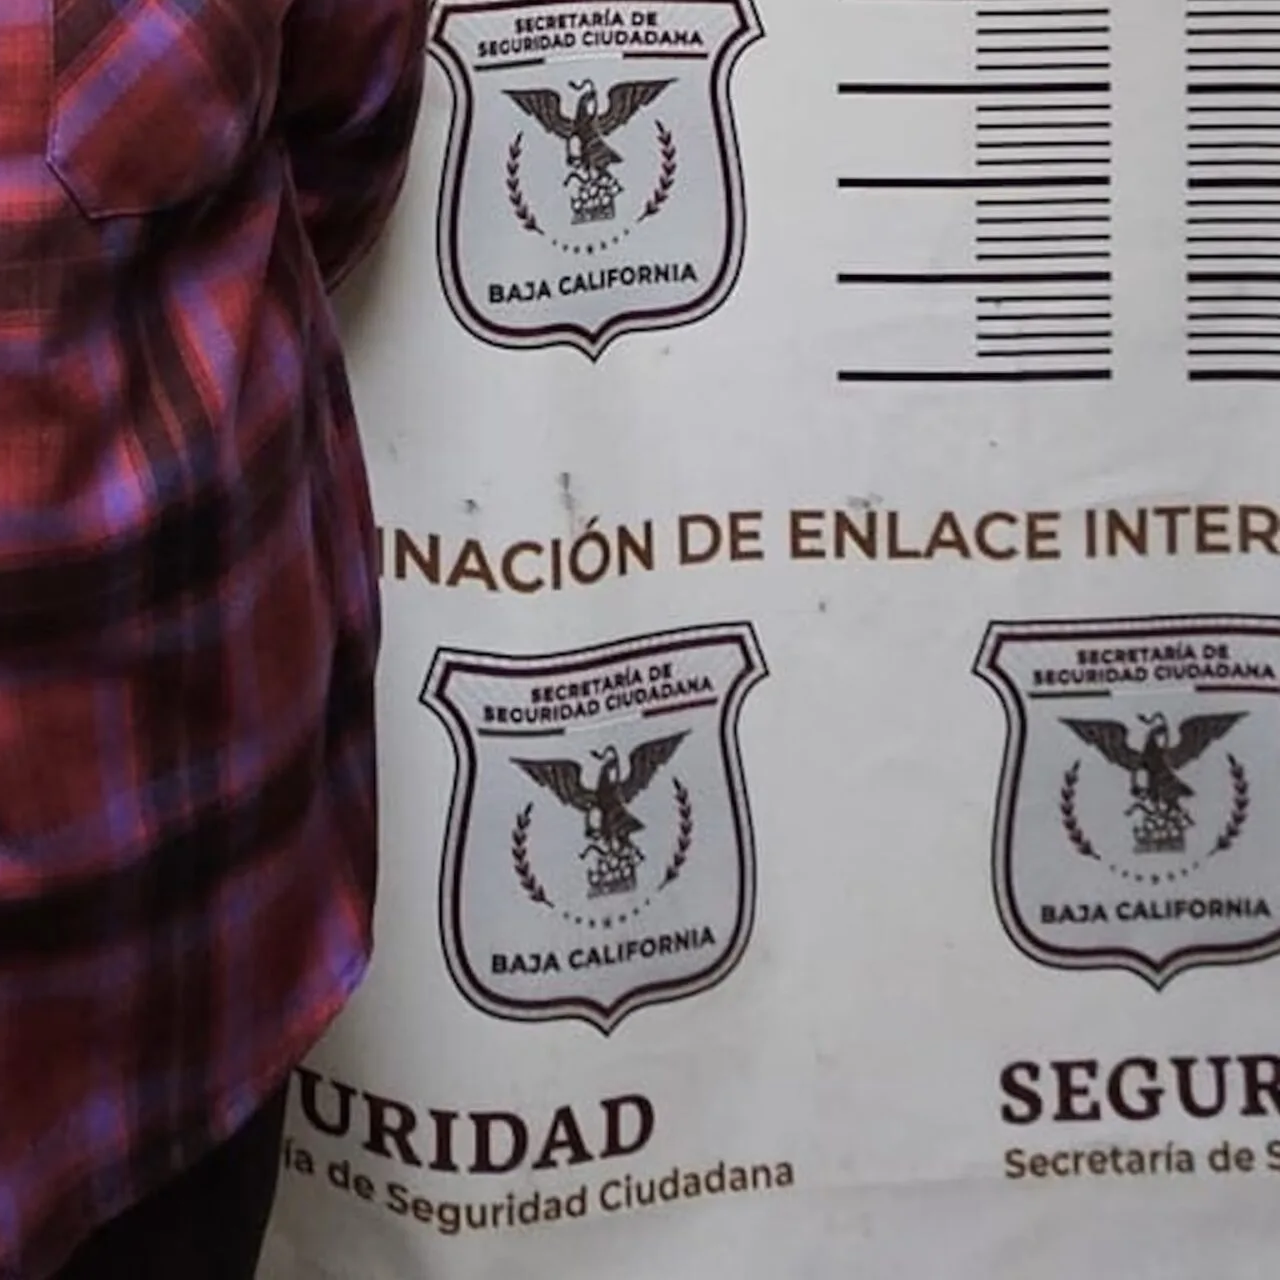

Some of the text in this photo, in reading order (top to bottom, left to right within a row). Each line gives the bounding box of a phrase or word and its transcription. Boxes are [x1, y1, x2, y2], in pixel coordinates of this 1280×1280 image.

[514, 7, 657, 33] SECRETARÍA DE
[477, 29, 704, 58] SEGURIDAD CIUDADANA
[488, 262, 698, 304] BAJA CALIFORNIA
[677, 510, 764, 565] DE
[789, 509, 1062, 561] ENLACE
[1085, 504, 1280, 559] INTER
[1076, 642, 1229, 667] SECRETARÍA DE
[482, 675, 714, 724] SEGURIDAD CIUDADANA
[530, 661, 672, 701] SECRETARÍA DE
[1040, 897, 1272, 925] BAJA CALIFORNIA
[491, 926, 717, 975] BAJA CALIFORNIA
[1004, 1141, 1196, 1180] Secretaría
[1207, 1140, 1256, 1174] de
[328, 1158, 375, 1202] de
[385, 1182, 588, 1236] Seguridad
[598, 1158, 796, 1212] Ciudadana
